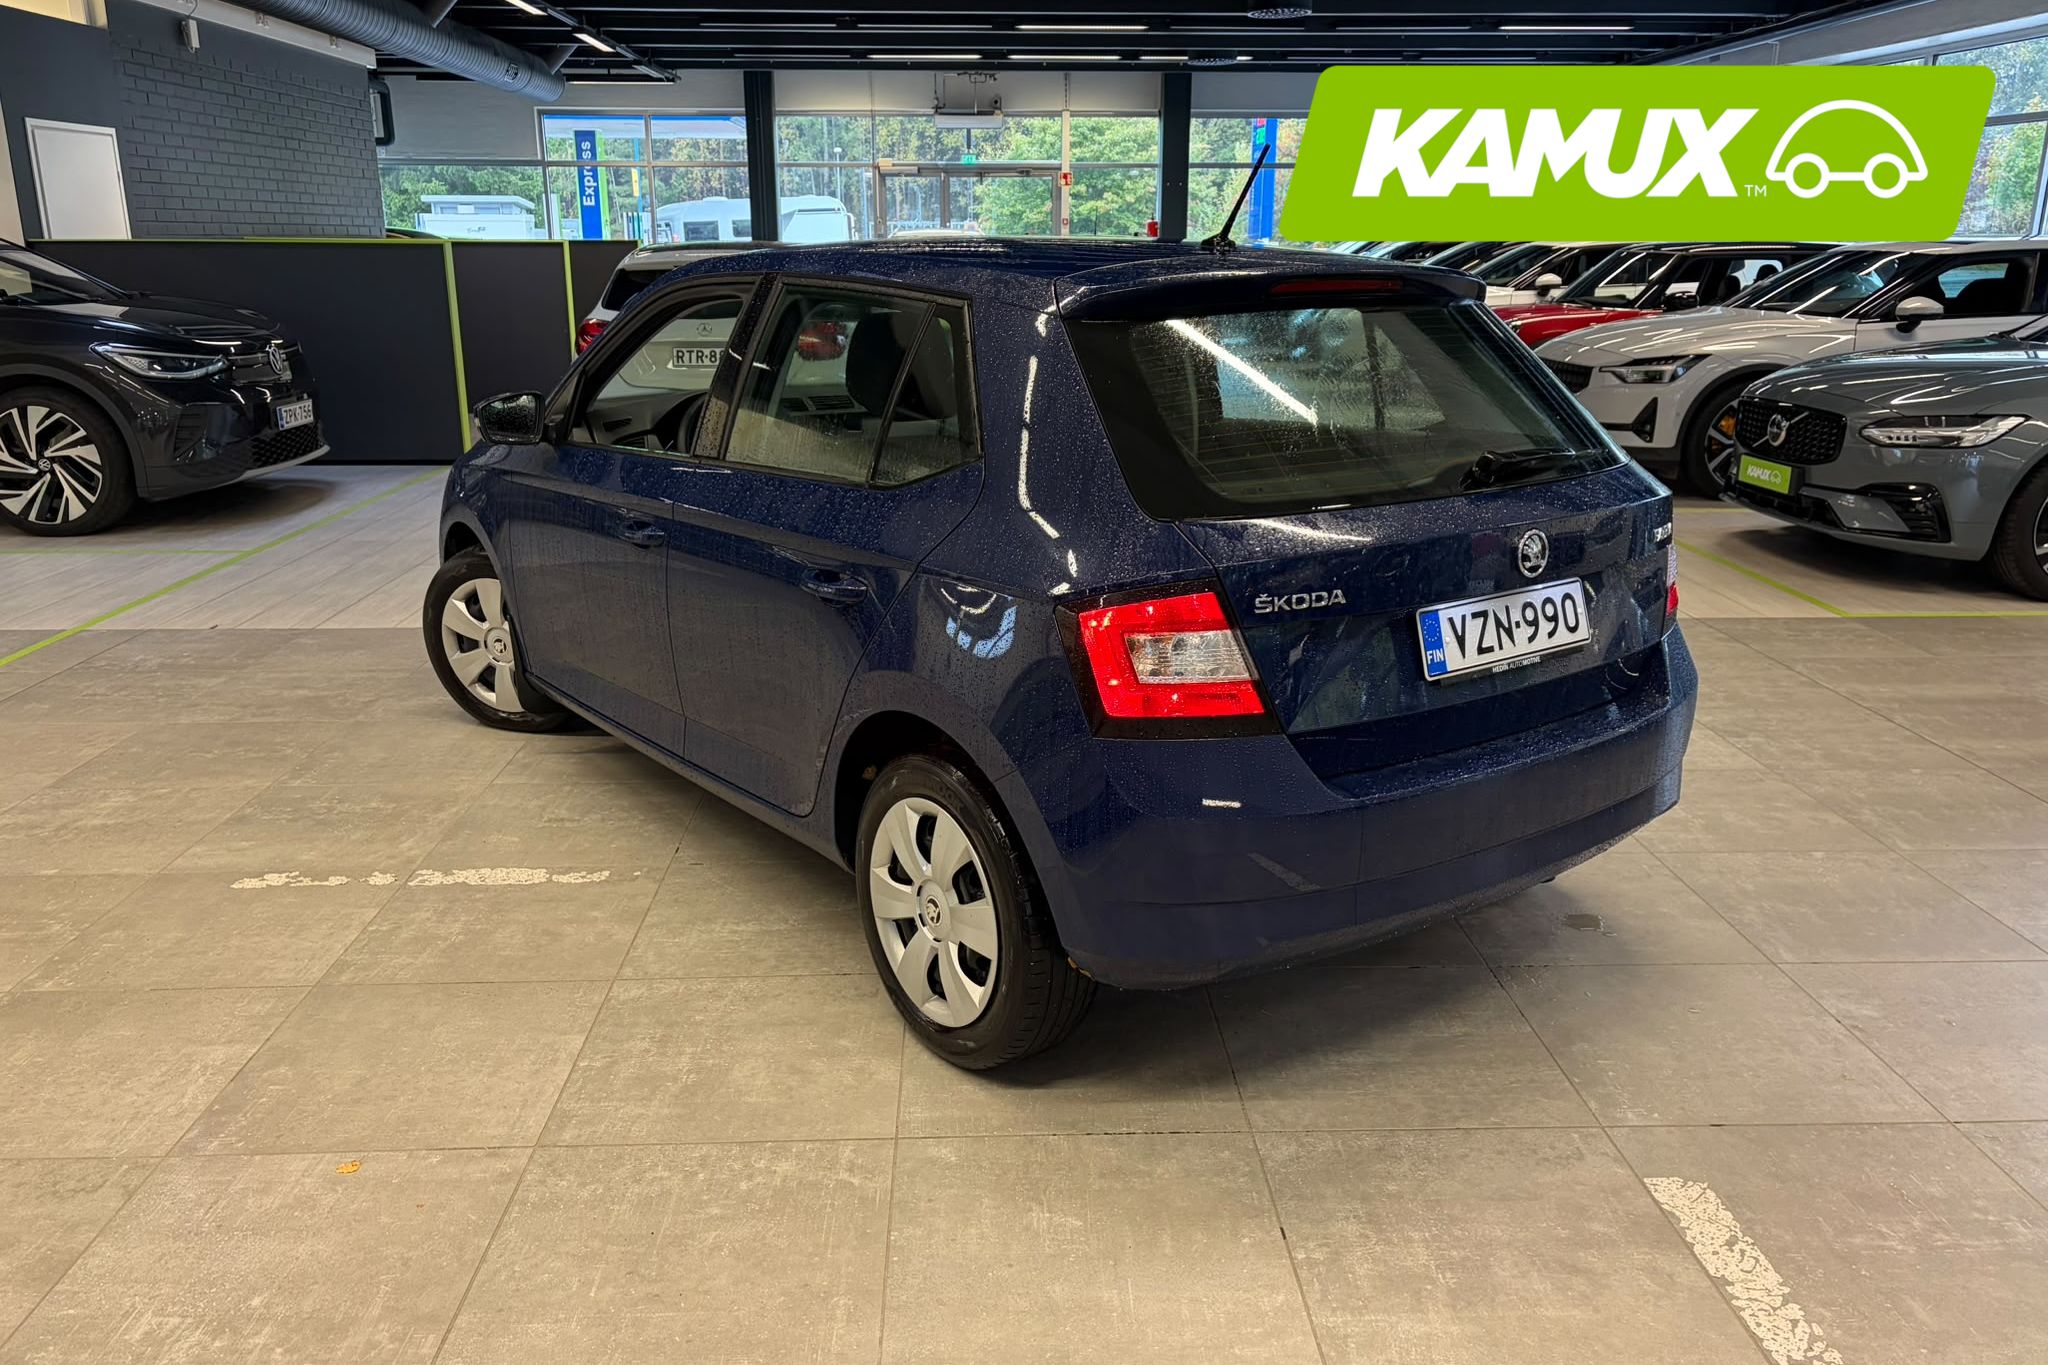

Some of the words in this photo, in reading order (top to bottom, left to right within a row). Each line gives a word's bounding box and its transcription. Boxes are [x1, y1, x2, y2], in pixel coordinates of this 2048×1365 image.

[675, 349, 726, 365] RTR-8
[283, 404, 312, 425] ZPK-756
[1746, 464, 1771, 481] KAMUX
[1254, 589, 1347, 614] ŠKODA
[1447, 592, 1580, 661] VZN-990
[1426, 648, 1445, 665] FIN
[1492, 664, 1509, 673] HEDIN
[1509, 655, 1542, 669] AUTOMOTIVE
